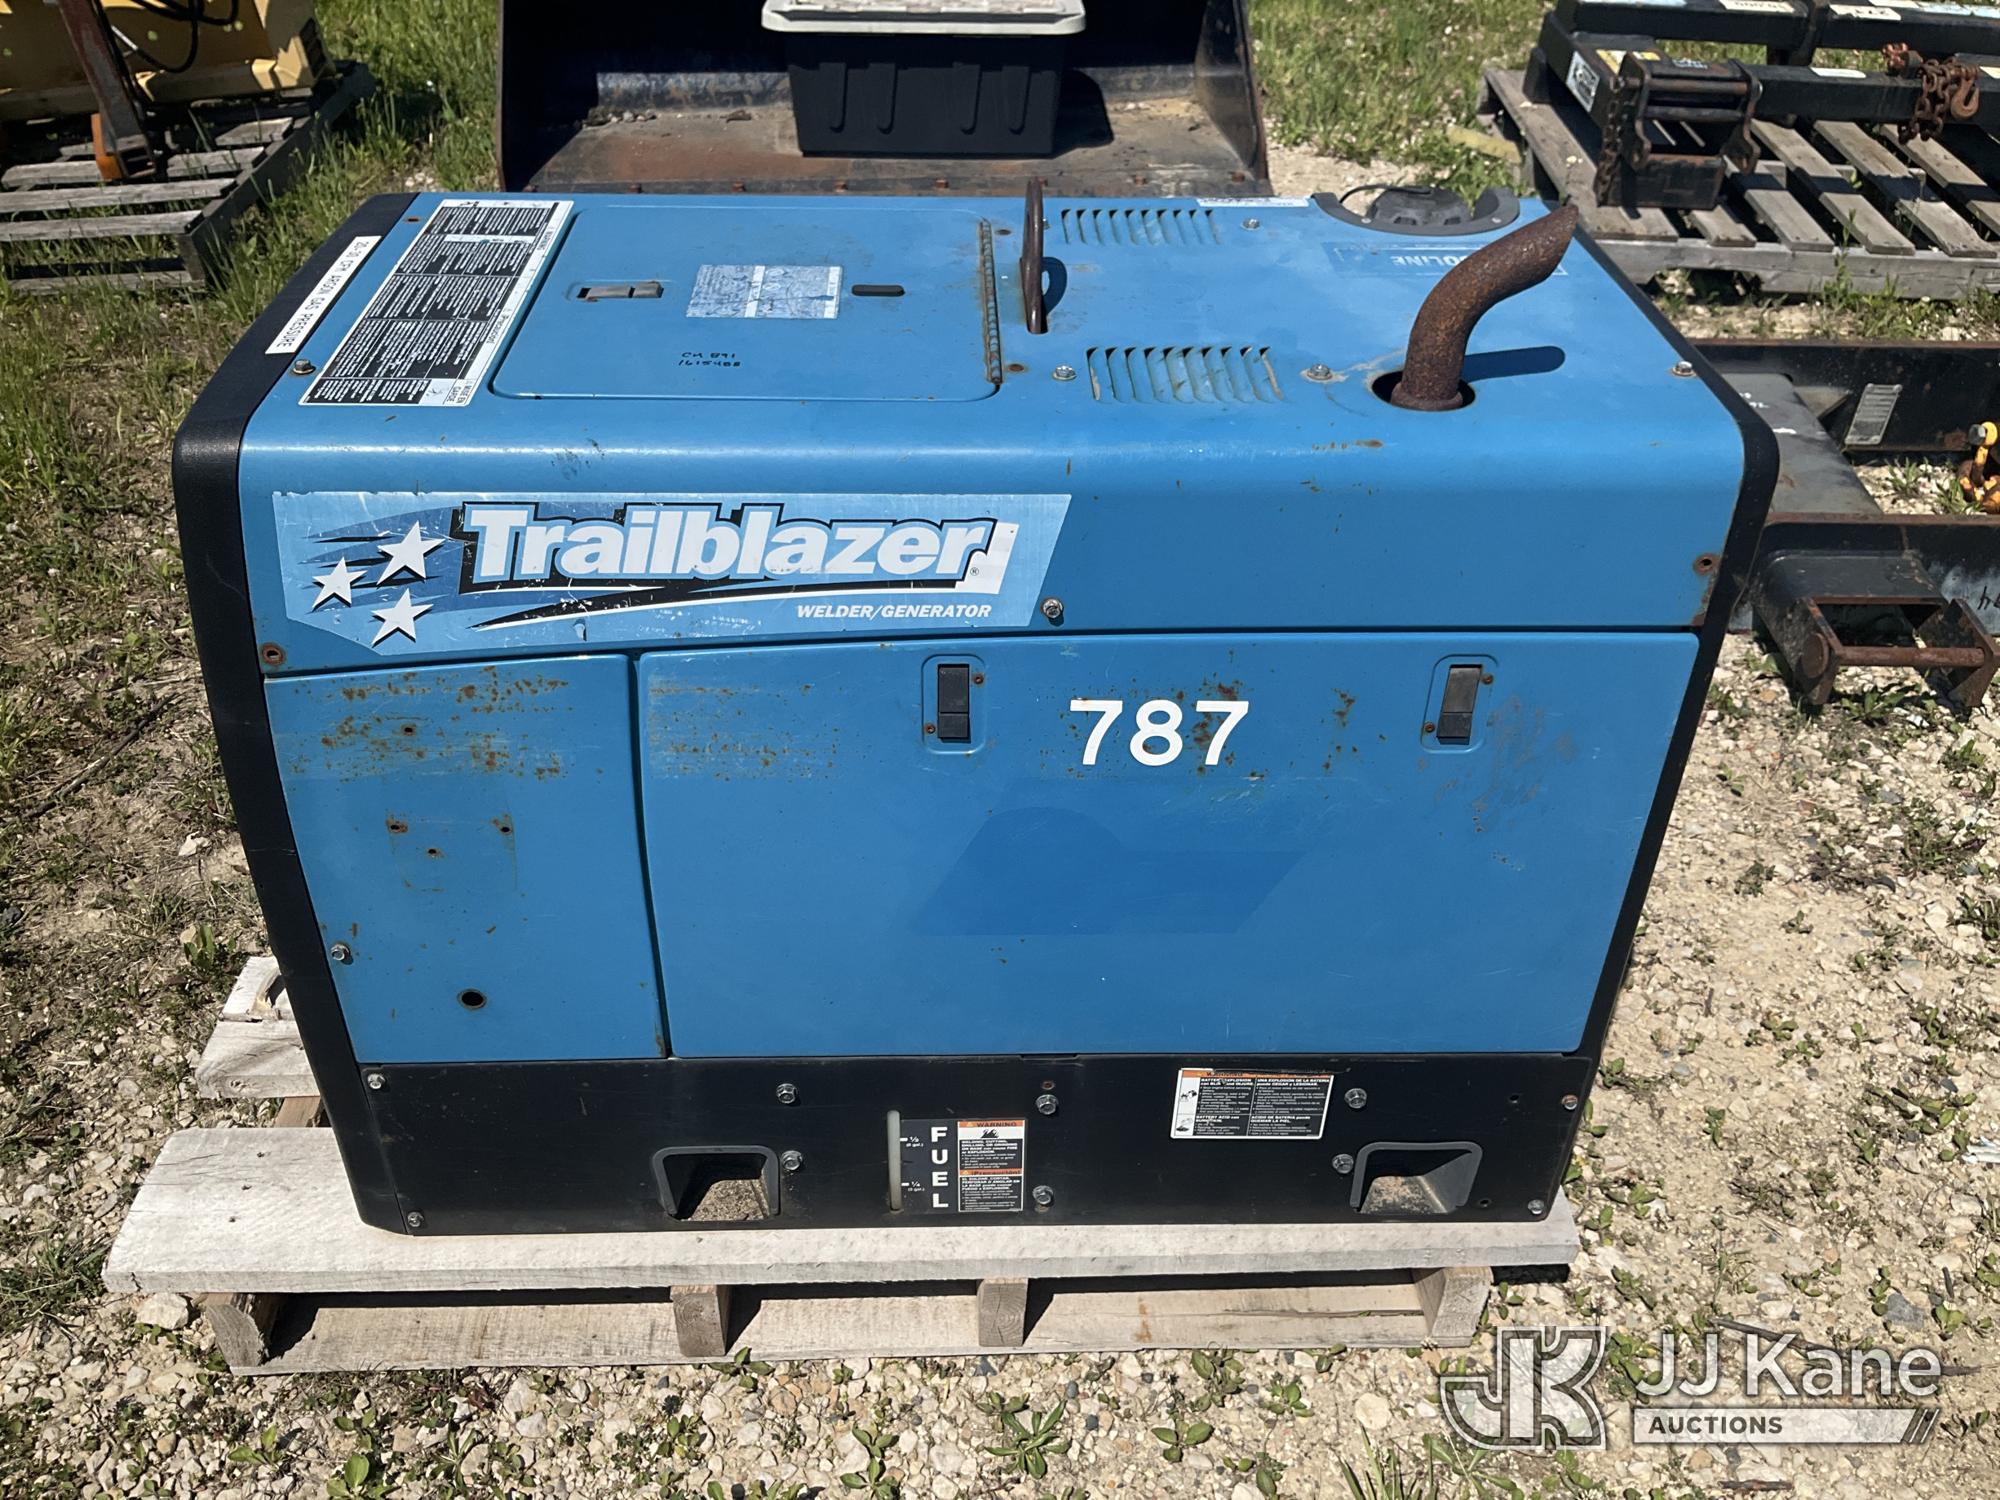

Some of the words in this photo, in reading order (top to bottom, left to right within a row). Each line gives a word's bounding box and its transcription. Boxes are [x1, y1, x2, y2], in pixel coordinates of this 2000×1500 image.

[317, 274, 343, 295] ARGON
[304, 296, 326, 311] GAS
[275, 312, 315, 348] PRESSURE
[796, 601, 993, 621] WELDER/GENERATOR
[1069, 698, 1250, 767] 787
[930, 1126, 950, 1209] FUEL
